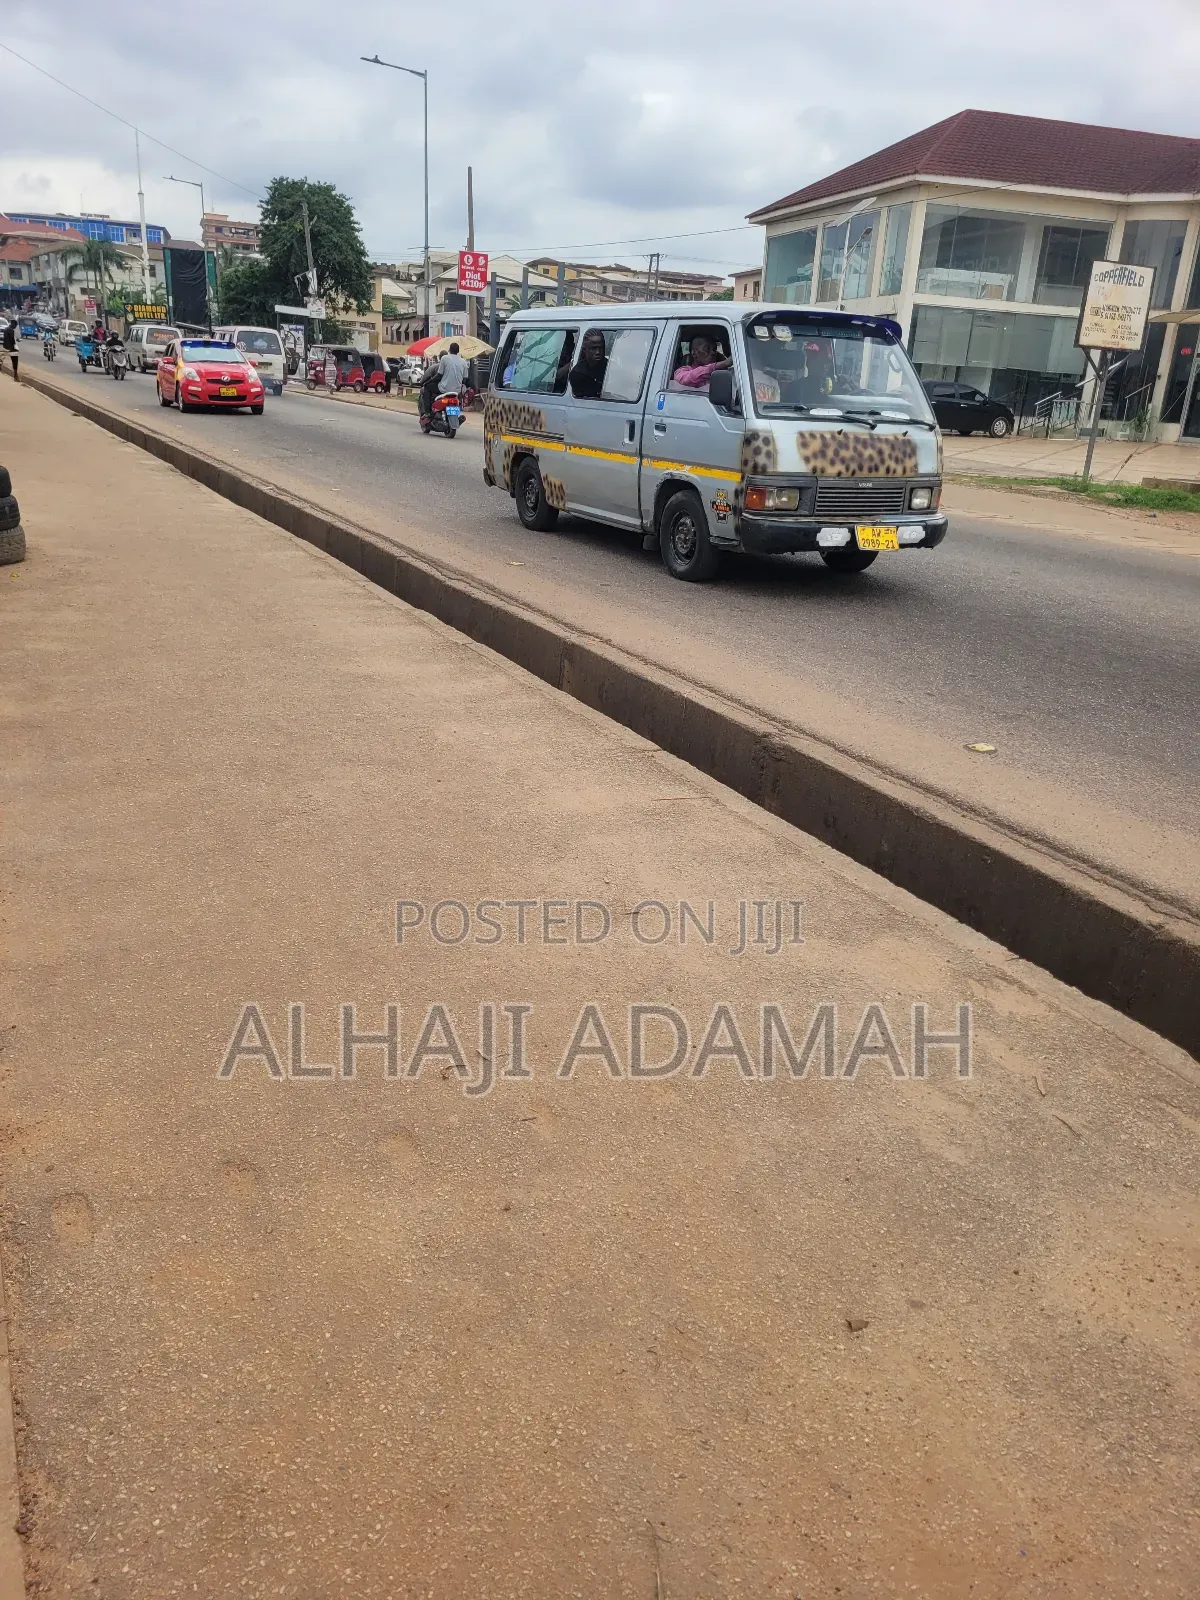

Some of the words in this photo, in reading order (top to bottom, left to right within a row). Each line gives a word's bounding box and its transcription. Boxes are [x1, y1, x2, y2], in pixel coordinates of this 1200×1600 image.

[466, 271, 481, 280] Dial
[1094, 266, 1144, 287] COPPERFIELD
[133, 304, 167, 313] DIAMOND
[134, 311, 154, 319] HOTEL
